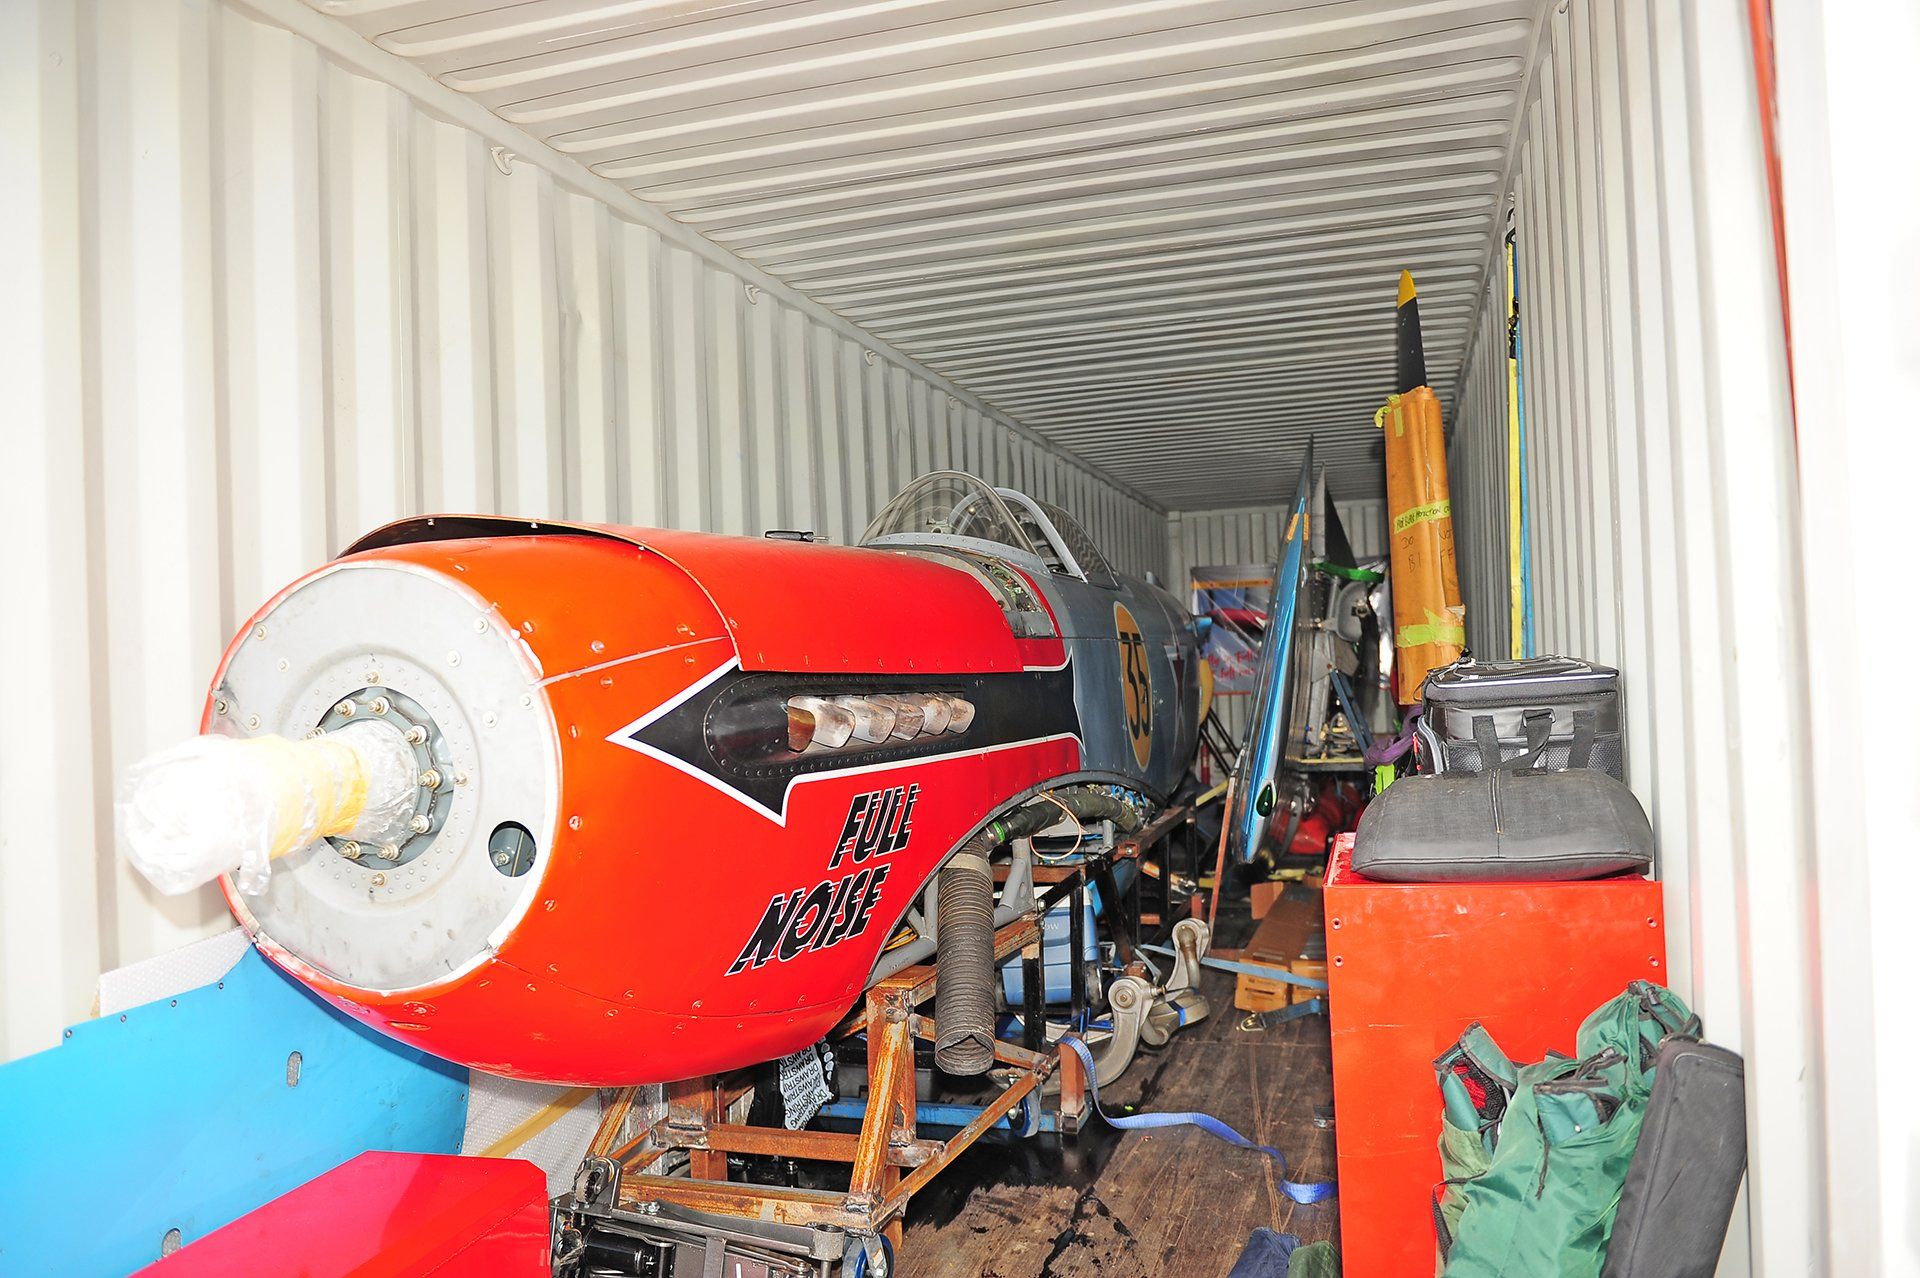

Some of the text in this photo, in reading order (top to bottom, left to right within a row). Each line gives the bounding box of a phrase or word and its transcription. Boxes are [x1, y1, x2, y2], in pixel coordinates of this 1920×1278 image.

[1120, 632, 1150, 740] 35
[827, 783, 921, 870] FULL
[724, 863, 891, 977] NOISE
